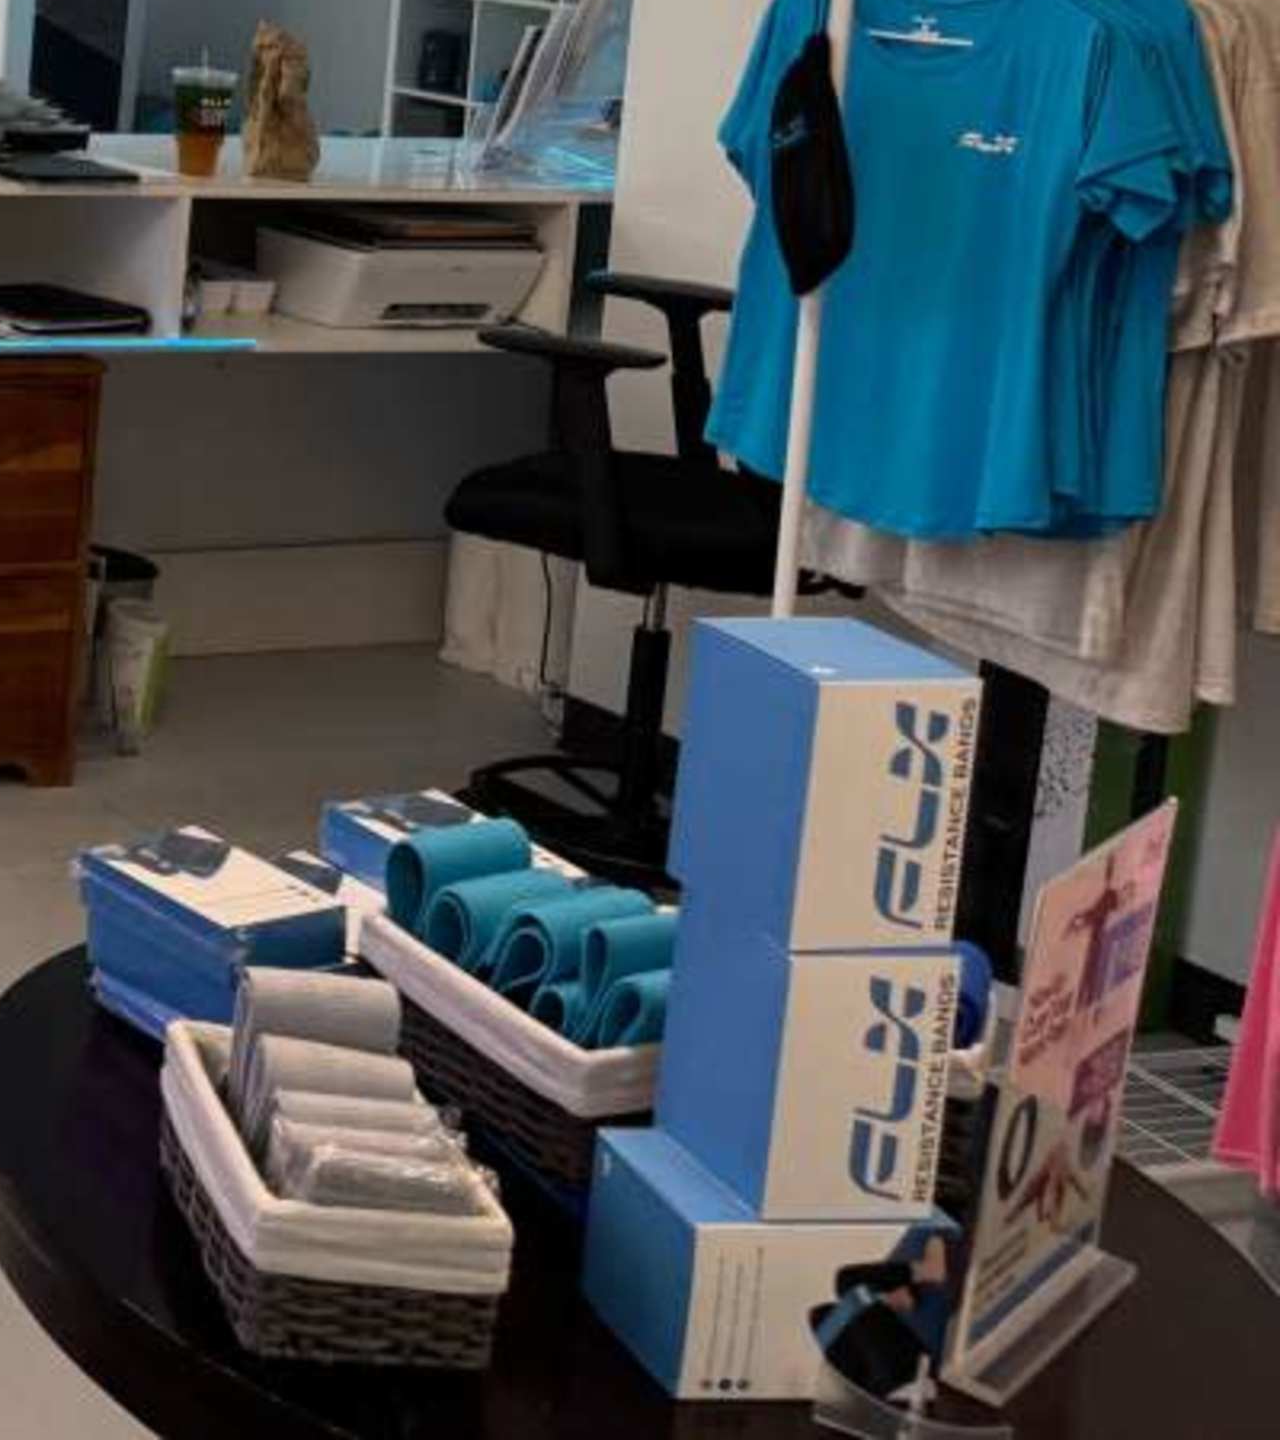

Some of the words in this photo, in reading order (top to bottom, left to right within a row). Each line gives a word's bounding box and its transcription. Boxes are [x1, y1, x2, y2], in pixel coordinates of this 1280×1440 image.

[873, 700, 950, 930] FLX
[933, 786, 967, 931] RESISTANCE
[848, 974, 926, 1202] FLX
[911, 1055, 945, 1203] RESISTANCE
